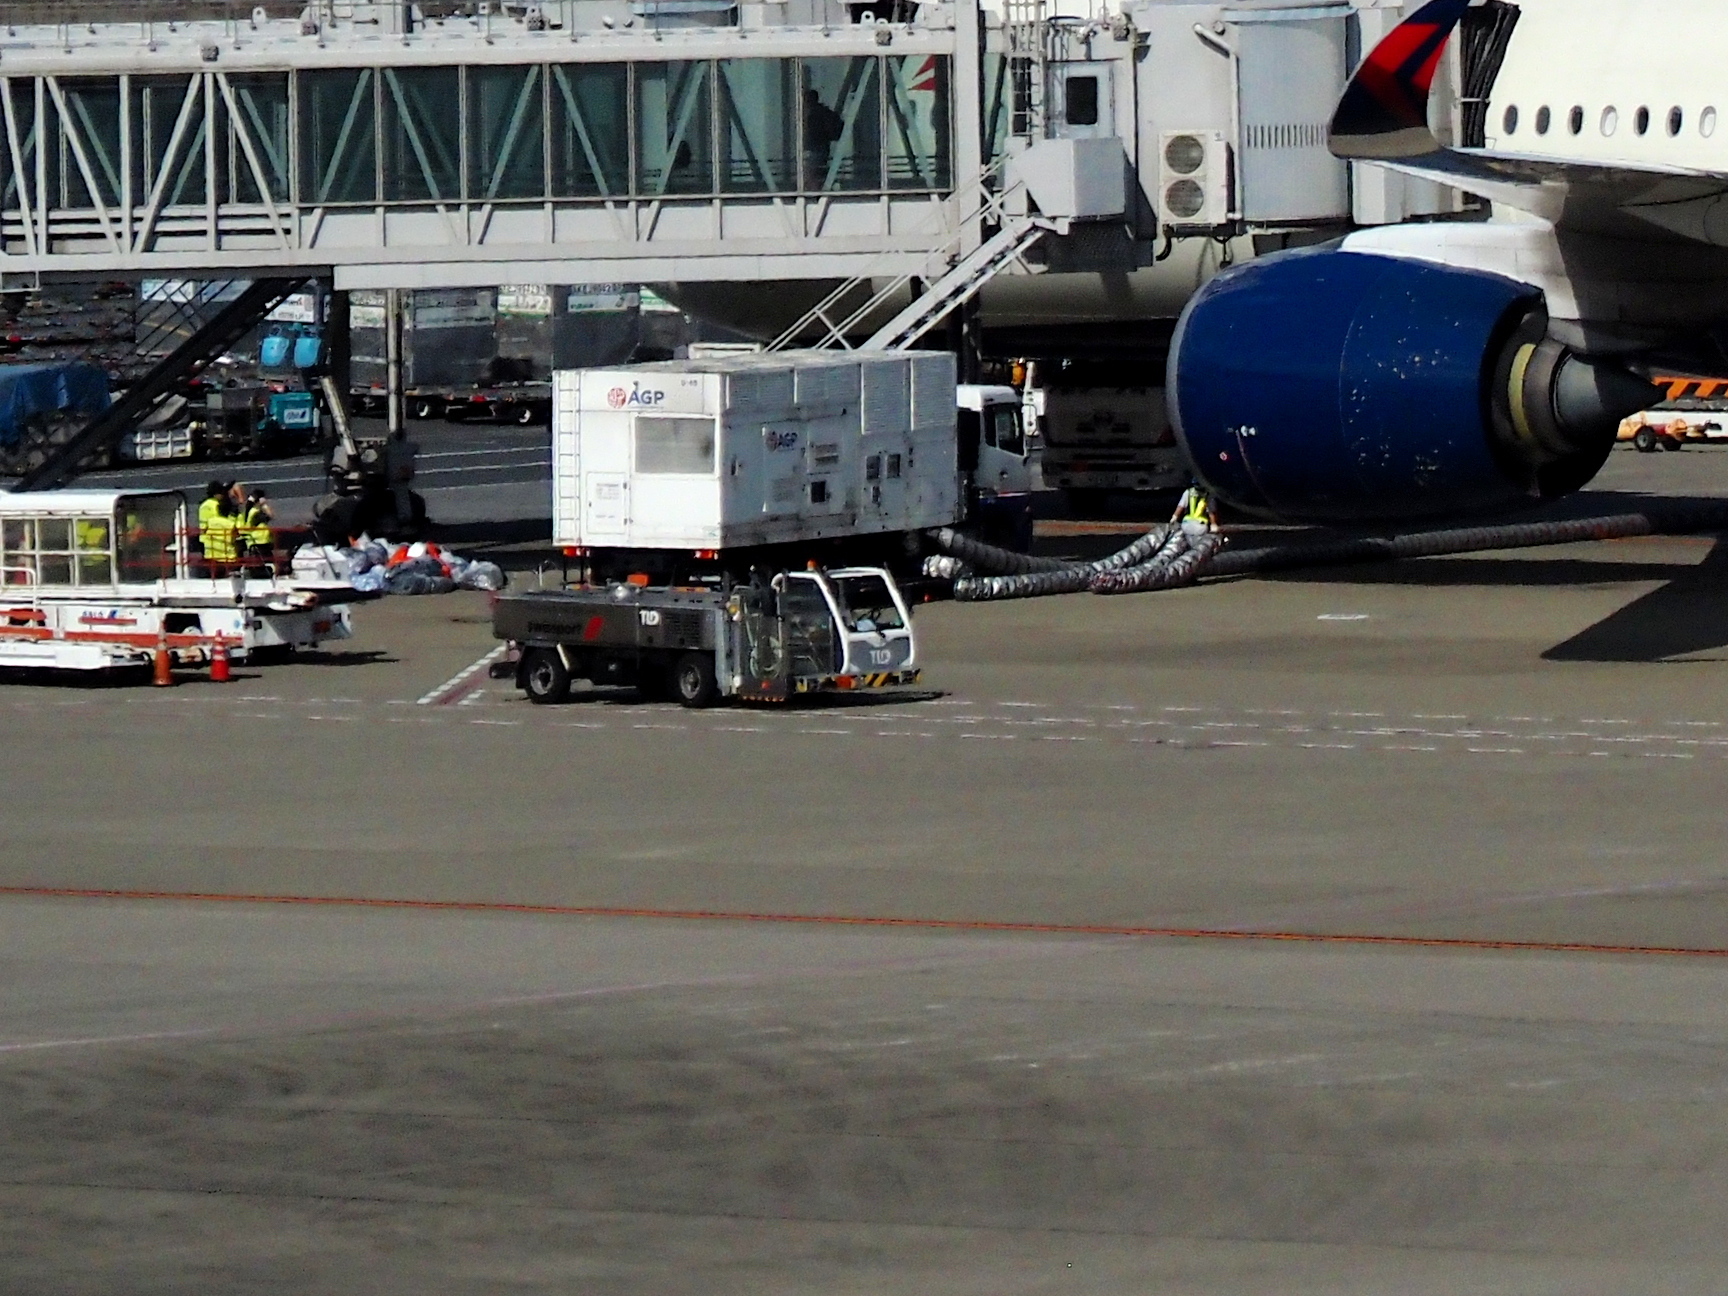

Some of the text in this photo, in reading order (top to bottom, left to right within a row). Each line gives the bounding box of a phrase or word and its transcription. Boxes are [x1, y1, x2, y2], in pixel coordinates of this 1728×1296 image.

[628, 391, 665, 406] AGP
[777, 432, 799, 448] AGP
[639, 610, 661, 626] TLD
[869, 649, 892, 666] TLD
